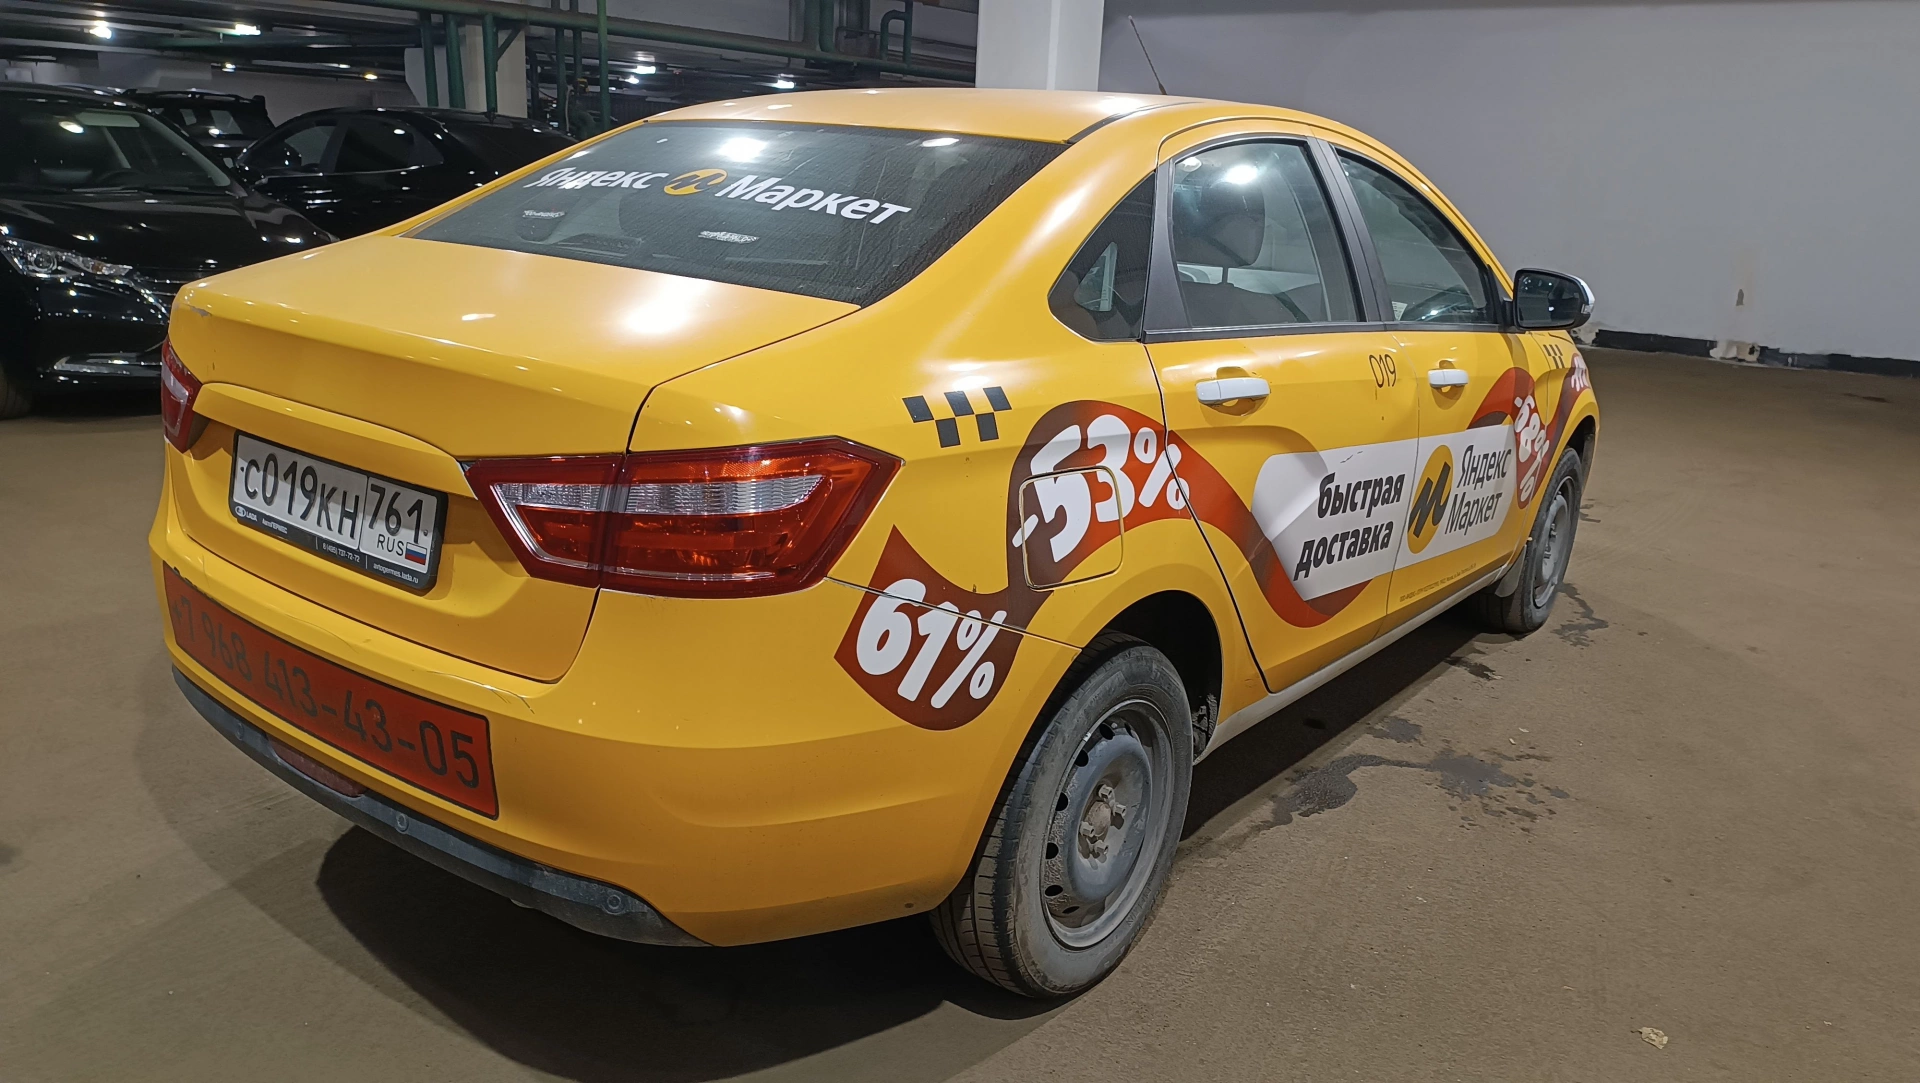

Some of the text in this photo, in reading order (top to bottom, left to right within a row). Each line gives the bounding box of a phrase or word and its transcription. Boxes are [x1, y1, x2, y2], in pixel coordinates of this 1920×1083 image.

[523, 167, 911, 225] Яндекс Маркет
[1368, 353, 1397, 389] 019
[1012, 414, 1190, 562] -53%
[1317, 472, 1406, 519] быстрая
[1456, 445, 1512, 490] Яндекс
[368, 483, 424, 544] 761
[1444, 492, 1503, 536] Маркет
[376, 533, 404, 556] RUS
[1293, 520, 1394, 582] доставка
[856, 578, 1007, 709] 61%
[201, 611, 252, 682] 968
[264, 651, 480, 789] 413-43-05
